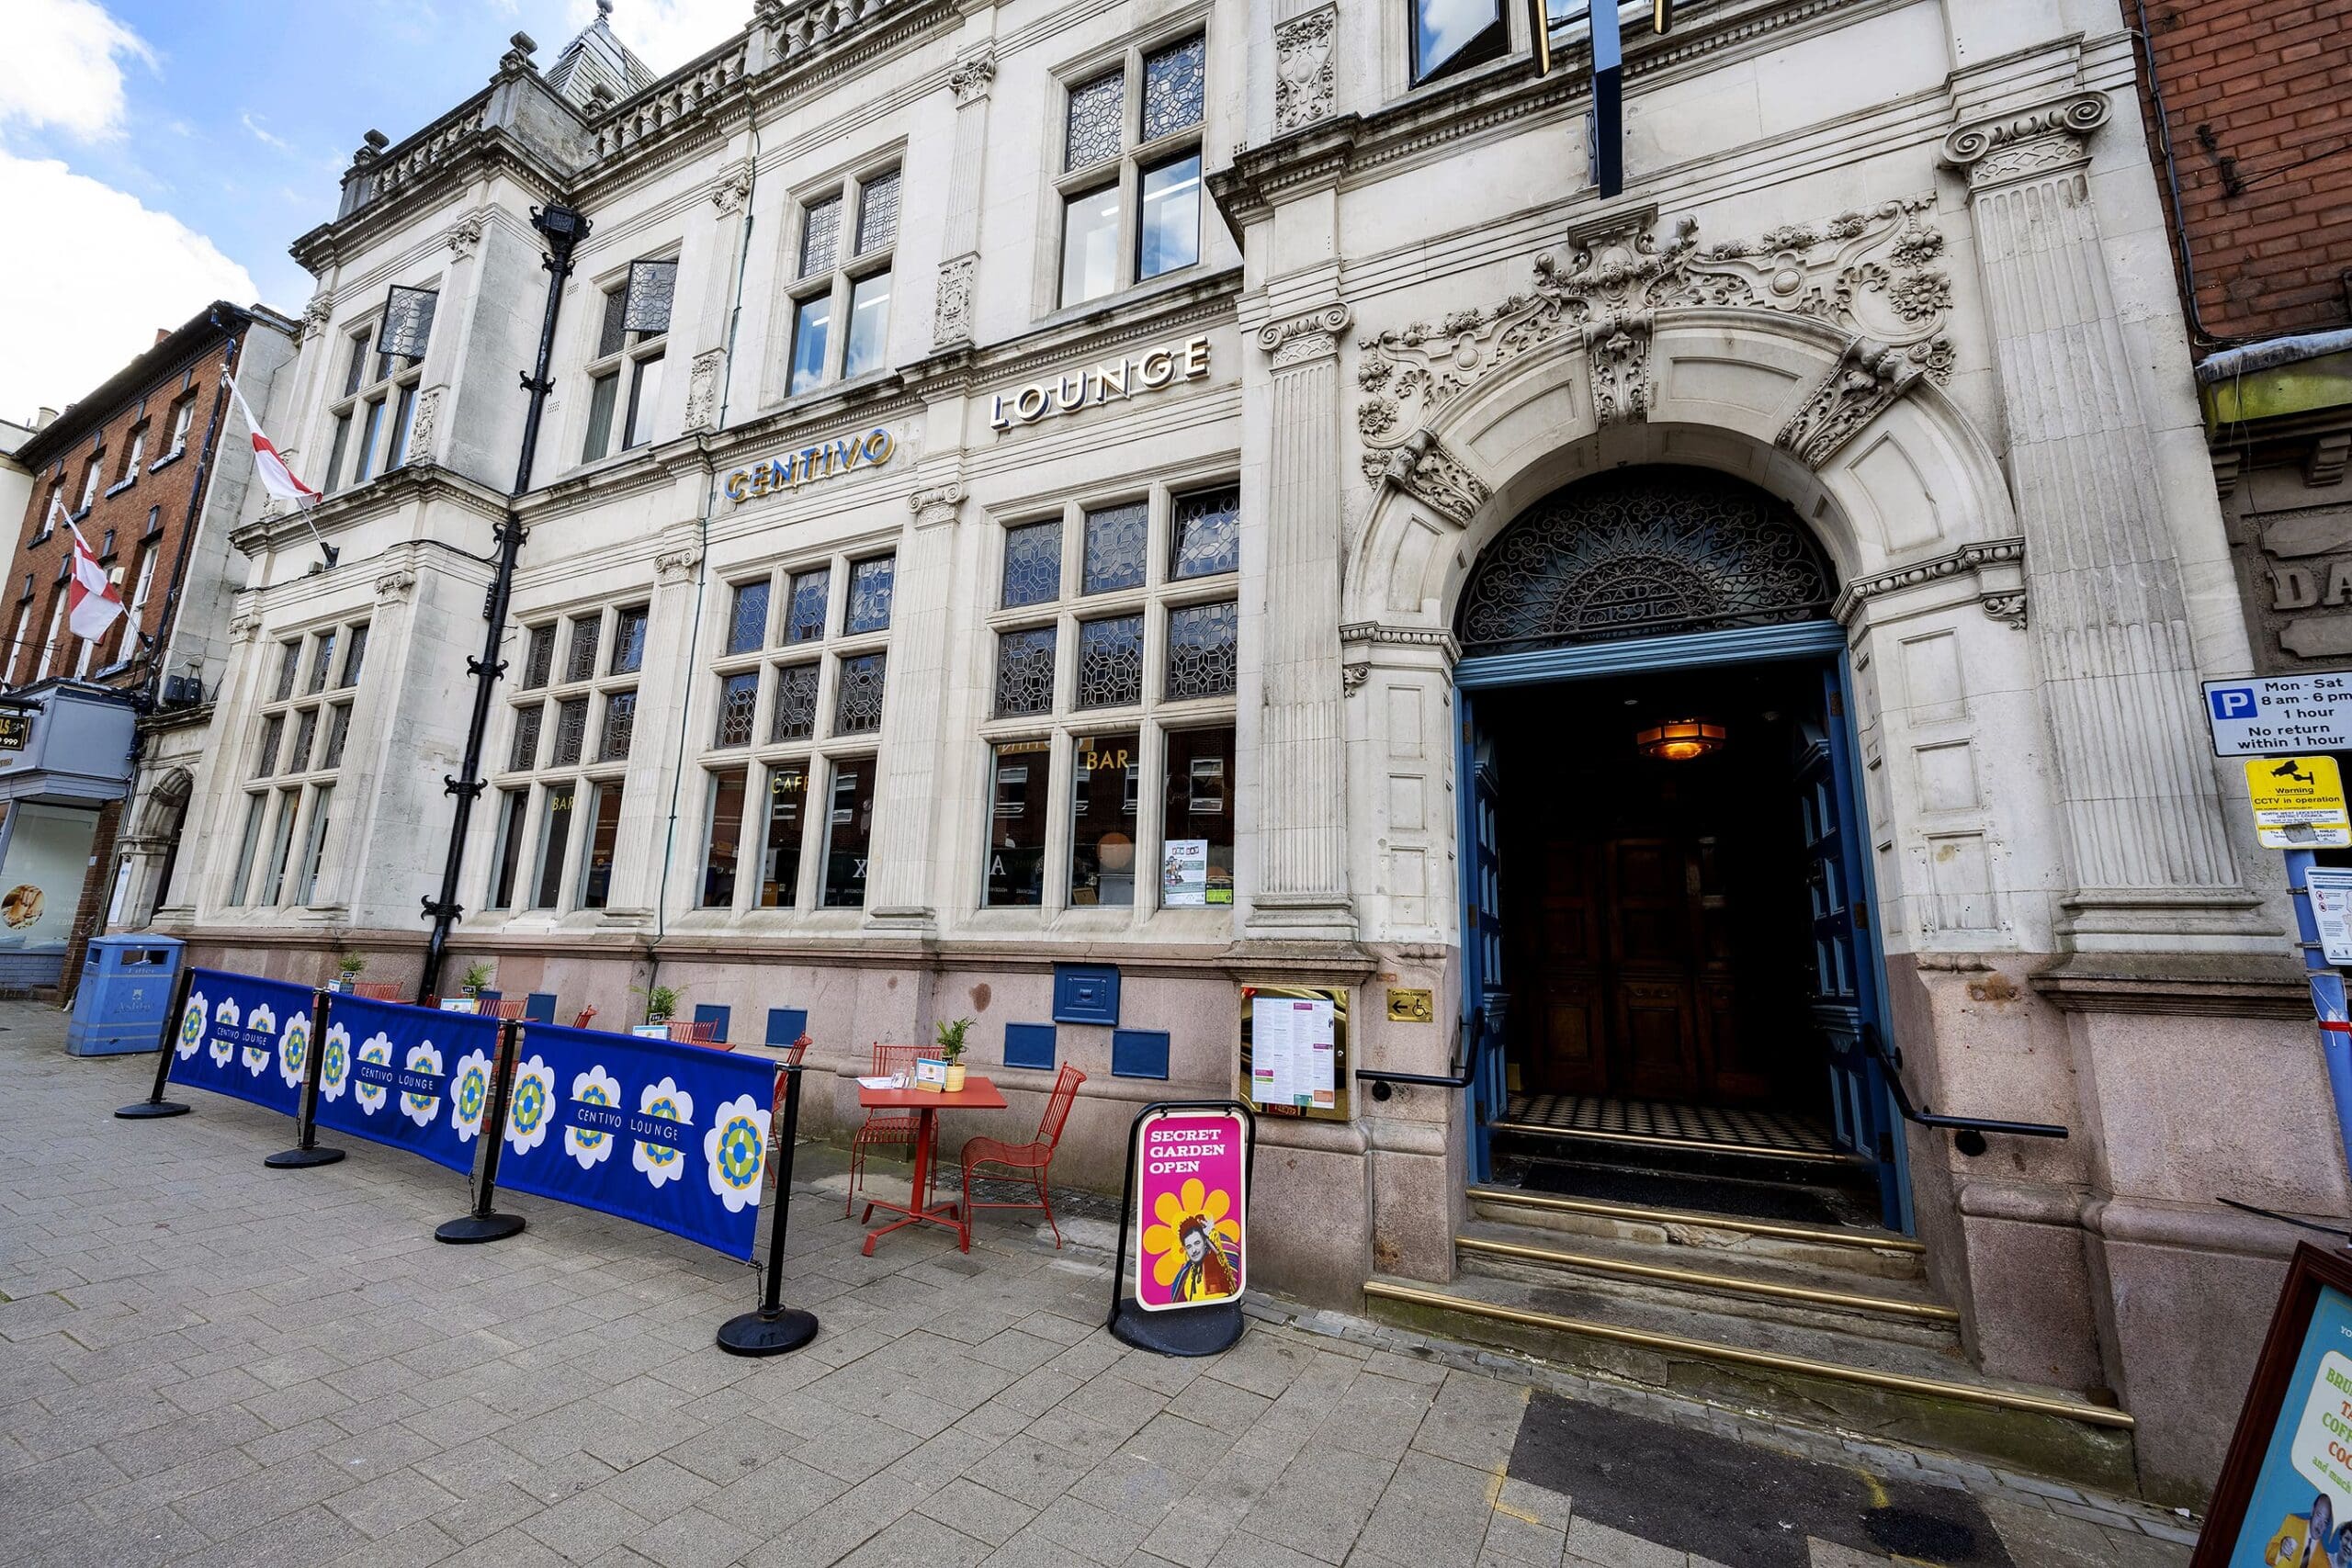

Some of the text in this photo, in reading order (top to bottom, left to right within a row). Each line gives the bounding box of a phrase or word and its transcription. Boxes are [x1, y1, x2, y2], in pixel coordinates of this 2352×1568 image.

[989, 335, 1211, 431] LOUNGE
[724, 428, 895, 502] CENTIVO
[1607, 601, 1656, 623] 1891
[2265, 682, 2301, 692] Mon
[2314, 678, 2344, 688] Sat
[2222, 693, 2249, 716] P
[2261, 696, 2272, 705] 8
[2276, 695, 2300, 705] am
[2313, 693, 2324, 702] 6
[2284, 708, 2335, 718] 1 hour
[2248, 724, 2331, 737] No return
[2238, 736, 2346, 749] within 1 hour
[1086, 750, 1130, 770] BAR
[552, 795, 574, 811] BAR
[2295, 795, 2340, 805] operation
[217, 1027, 267, 1046] CENTIVO LOUNGE
[361, 1066, 434, 1090] CENTIVO LOUNGE
[578, 1109, 678, 1141] CENTIVO LOUNGE
[1150, 1129, 1221, 1143] SECRET
[1149, 1144, 1226, 1158] GARDEN
[1148, 1160, 1200, 1175] OPEN
[2312, 1456, 2352, 1495] and much
